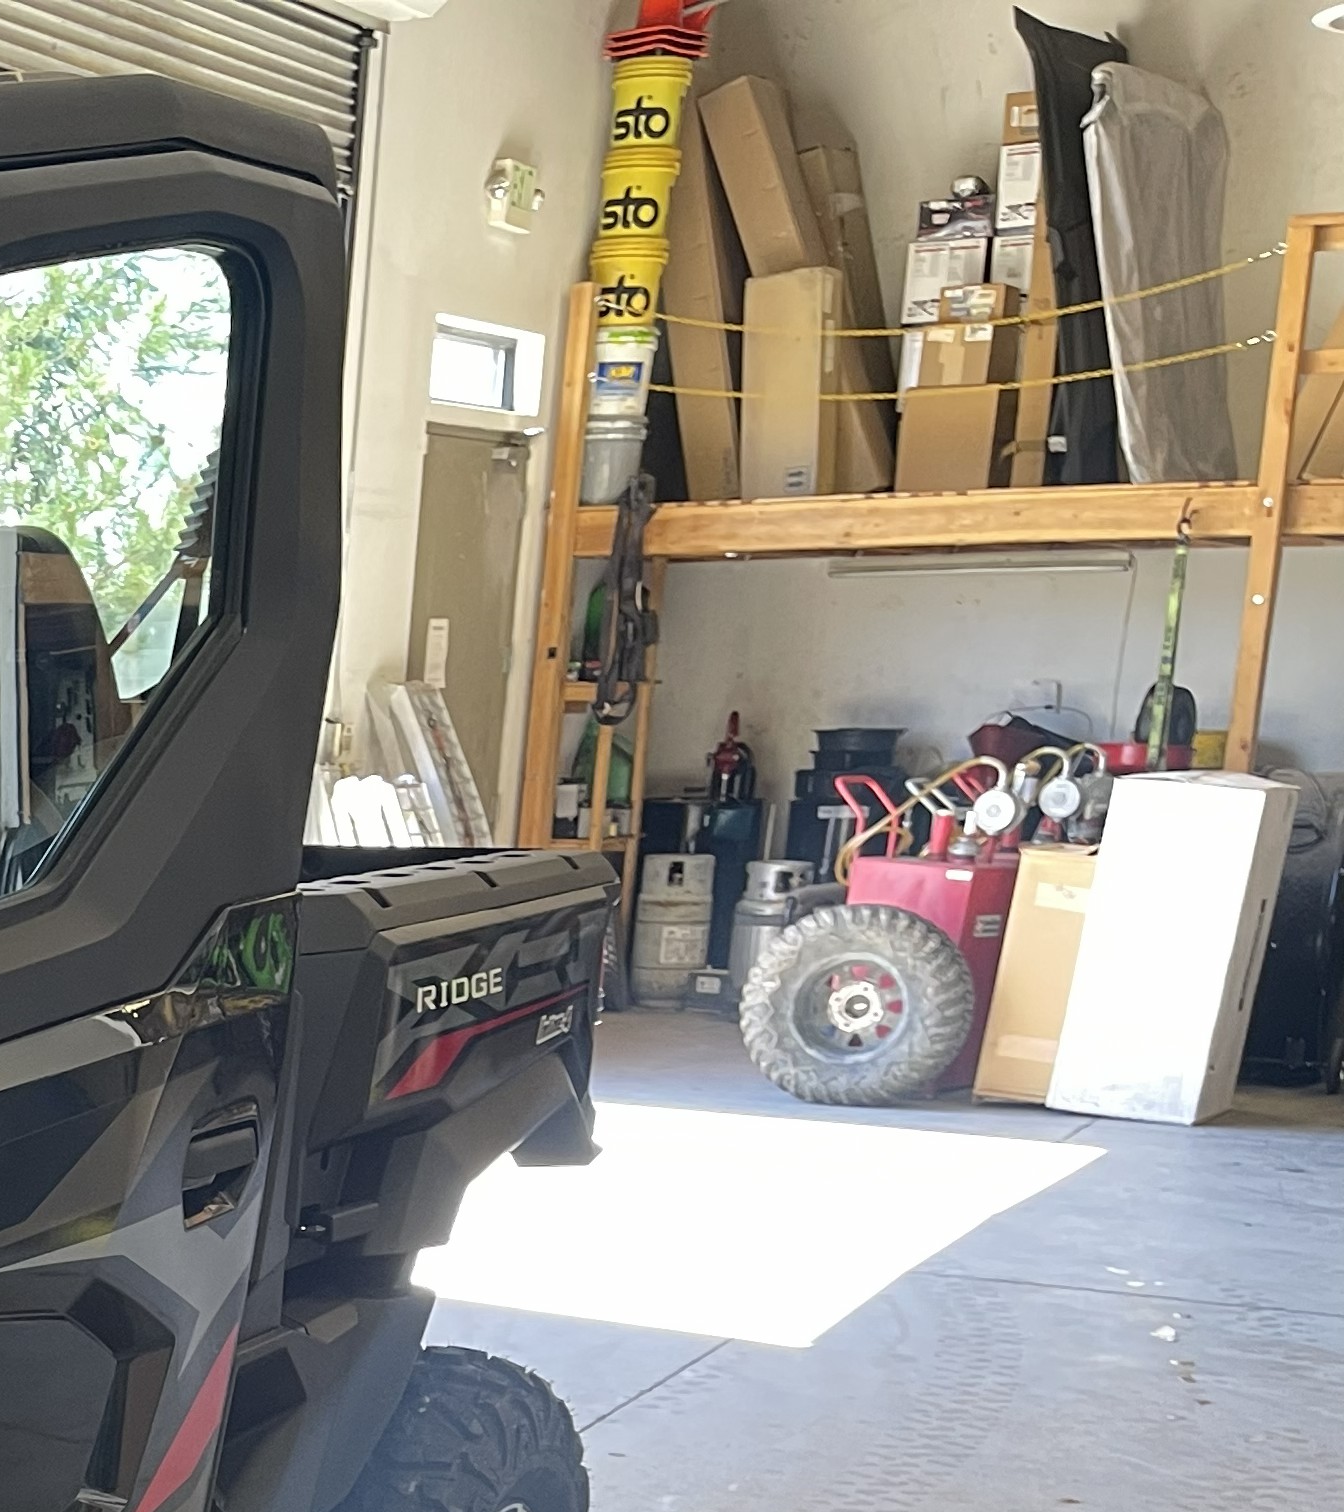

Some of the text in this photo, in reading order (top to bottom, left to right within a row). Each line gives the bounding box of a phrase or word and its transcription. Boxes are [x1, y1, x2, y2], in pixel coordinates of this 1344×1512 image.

[614, 96, 670, 141] sto
[602, 186, 660, 230] sto
[416, 967, 503, 1014] RIDGE
